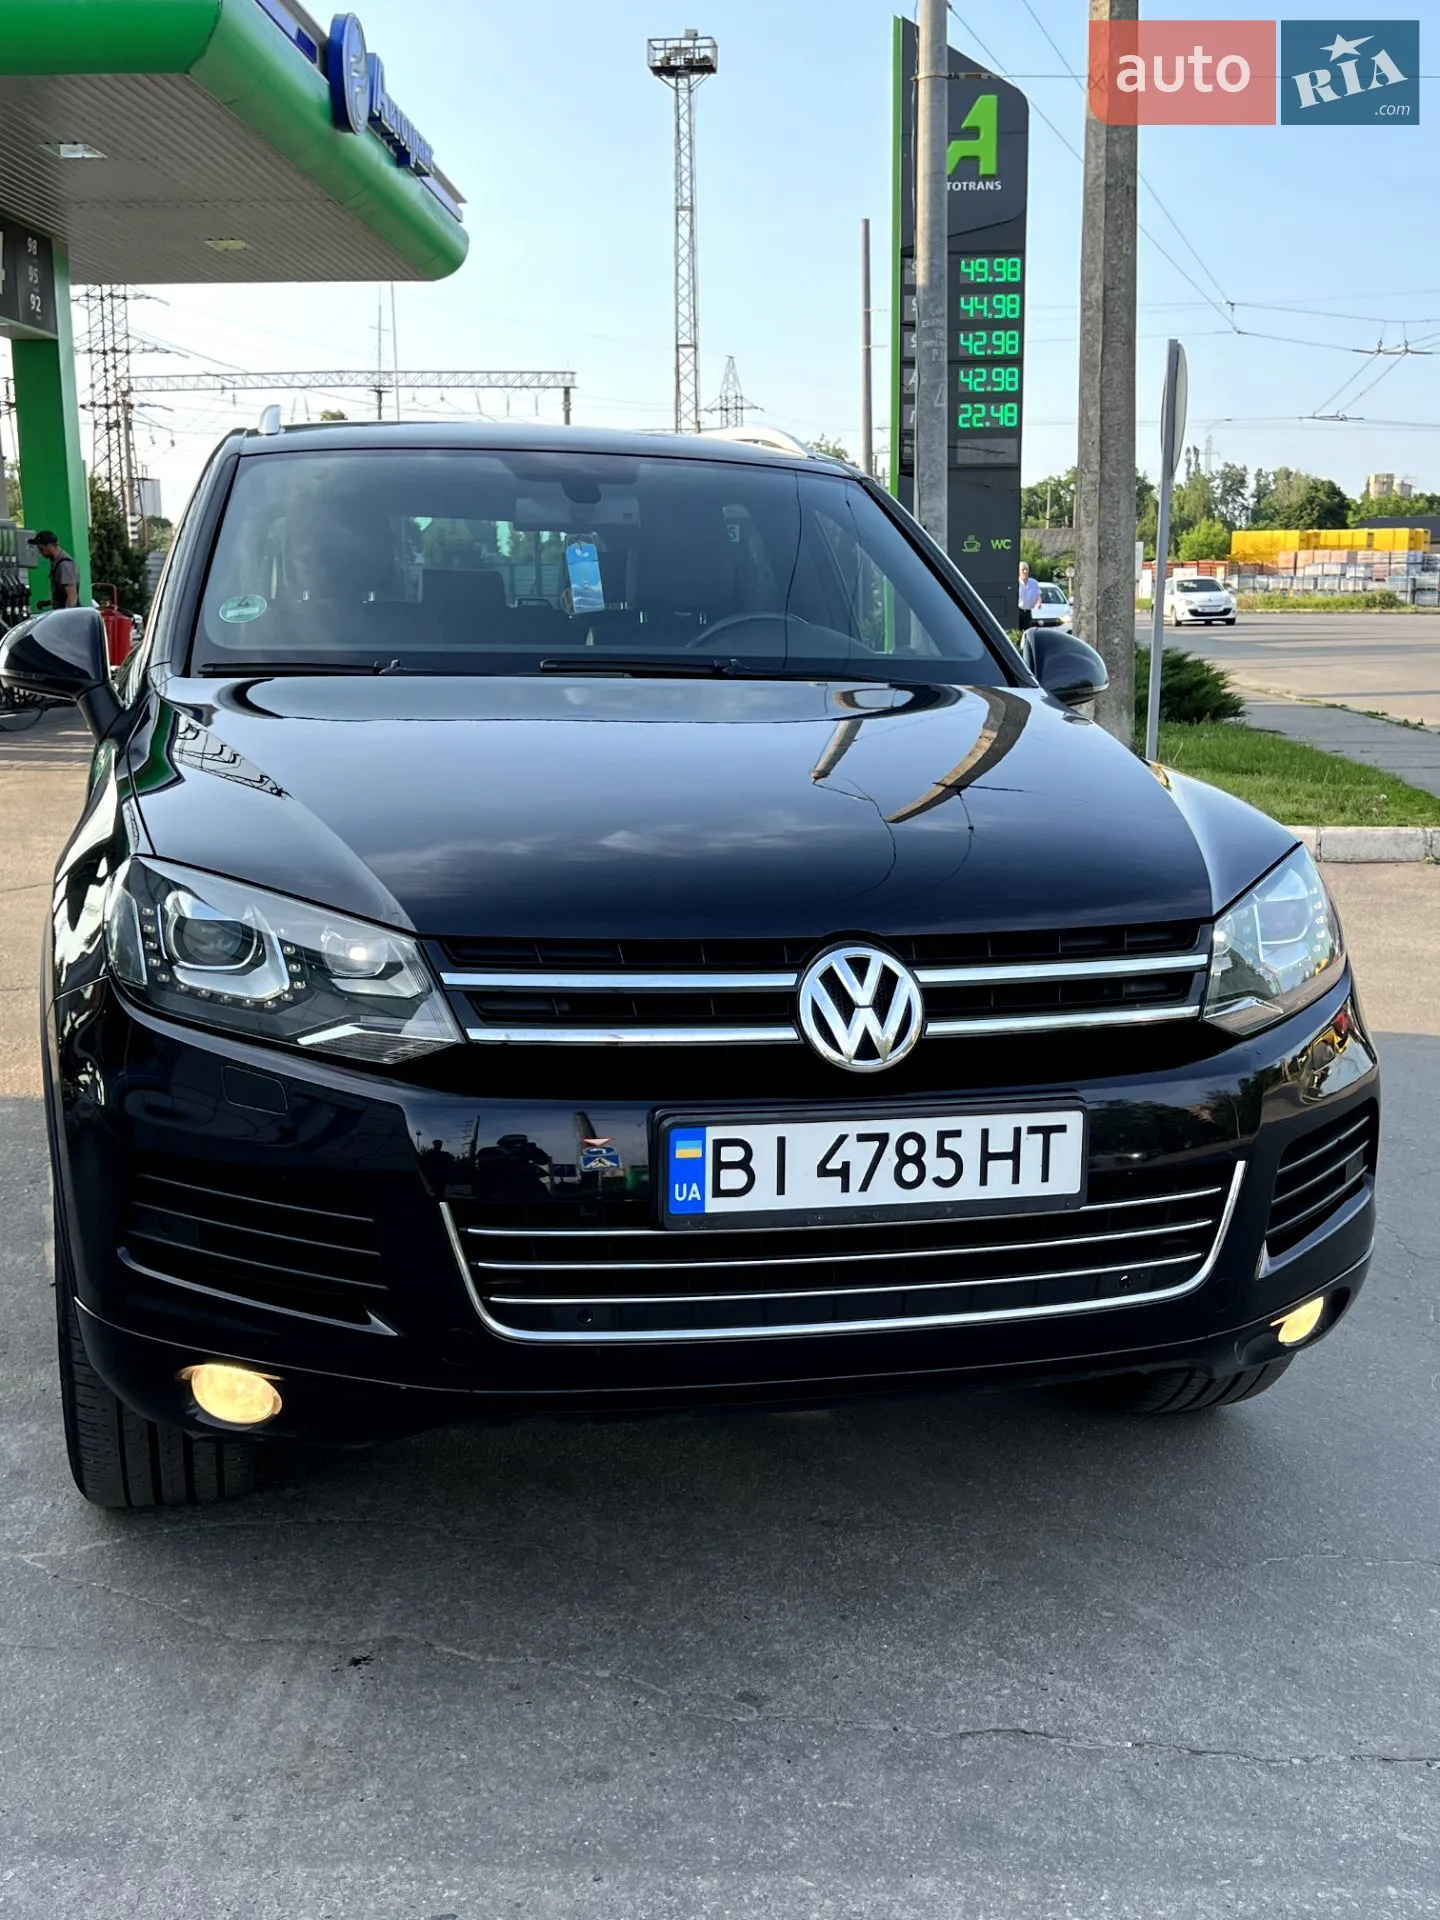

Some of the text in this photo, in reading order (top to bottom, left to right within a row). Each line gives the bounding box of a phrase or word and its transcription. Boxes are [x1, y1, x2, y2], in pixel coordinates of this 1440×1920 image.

[946, 180, 1002, 191] TOTRANS
[27, 236, 38, 256] 98
[960, 257, 1021, 282] 49.98
[30, 293, 42, 313] 92
[960, 294, 1020, 319] 44.98
[960, 330, 1019, 355] 42.98
[959, 367, 1019, 392] 42.98
[958, 402, 1018, 428] 22.48
[990, 538, 1012, 550] WC
[711, 1123, 1068, 1200] BI 4785 HT
[674, 1183, 702, 1202] UA
